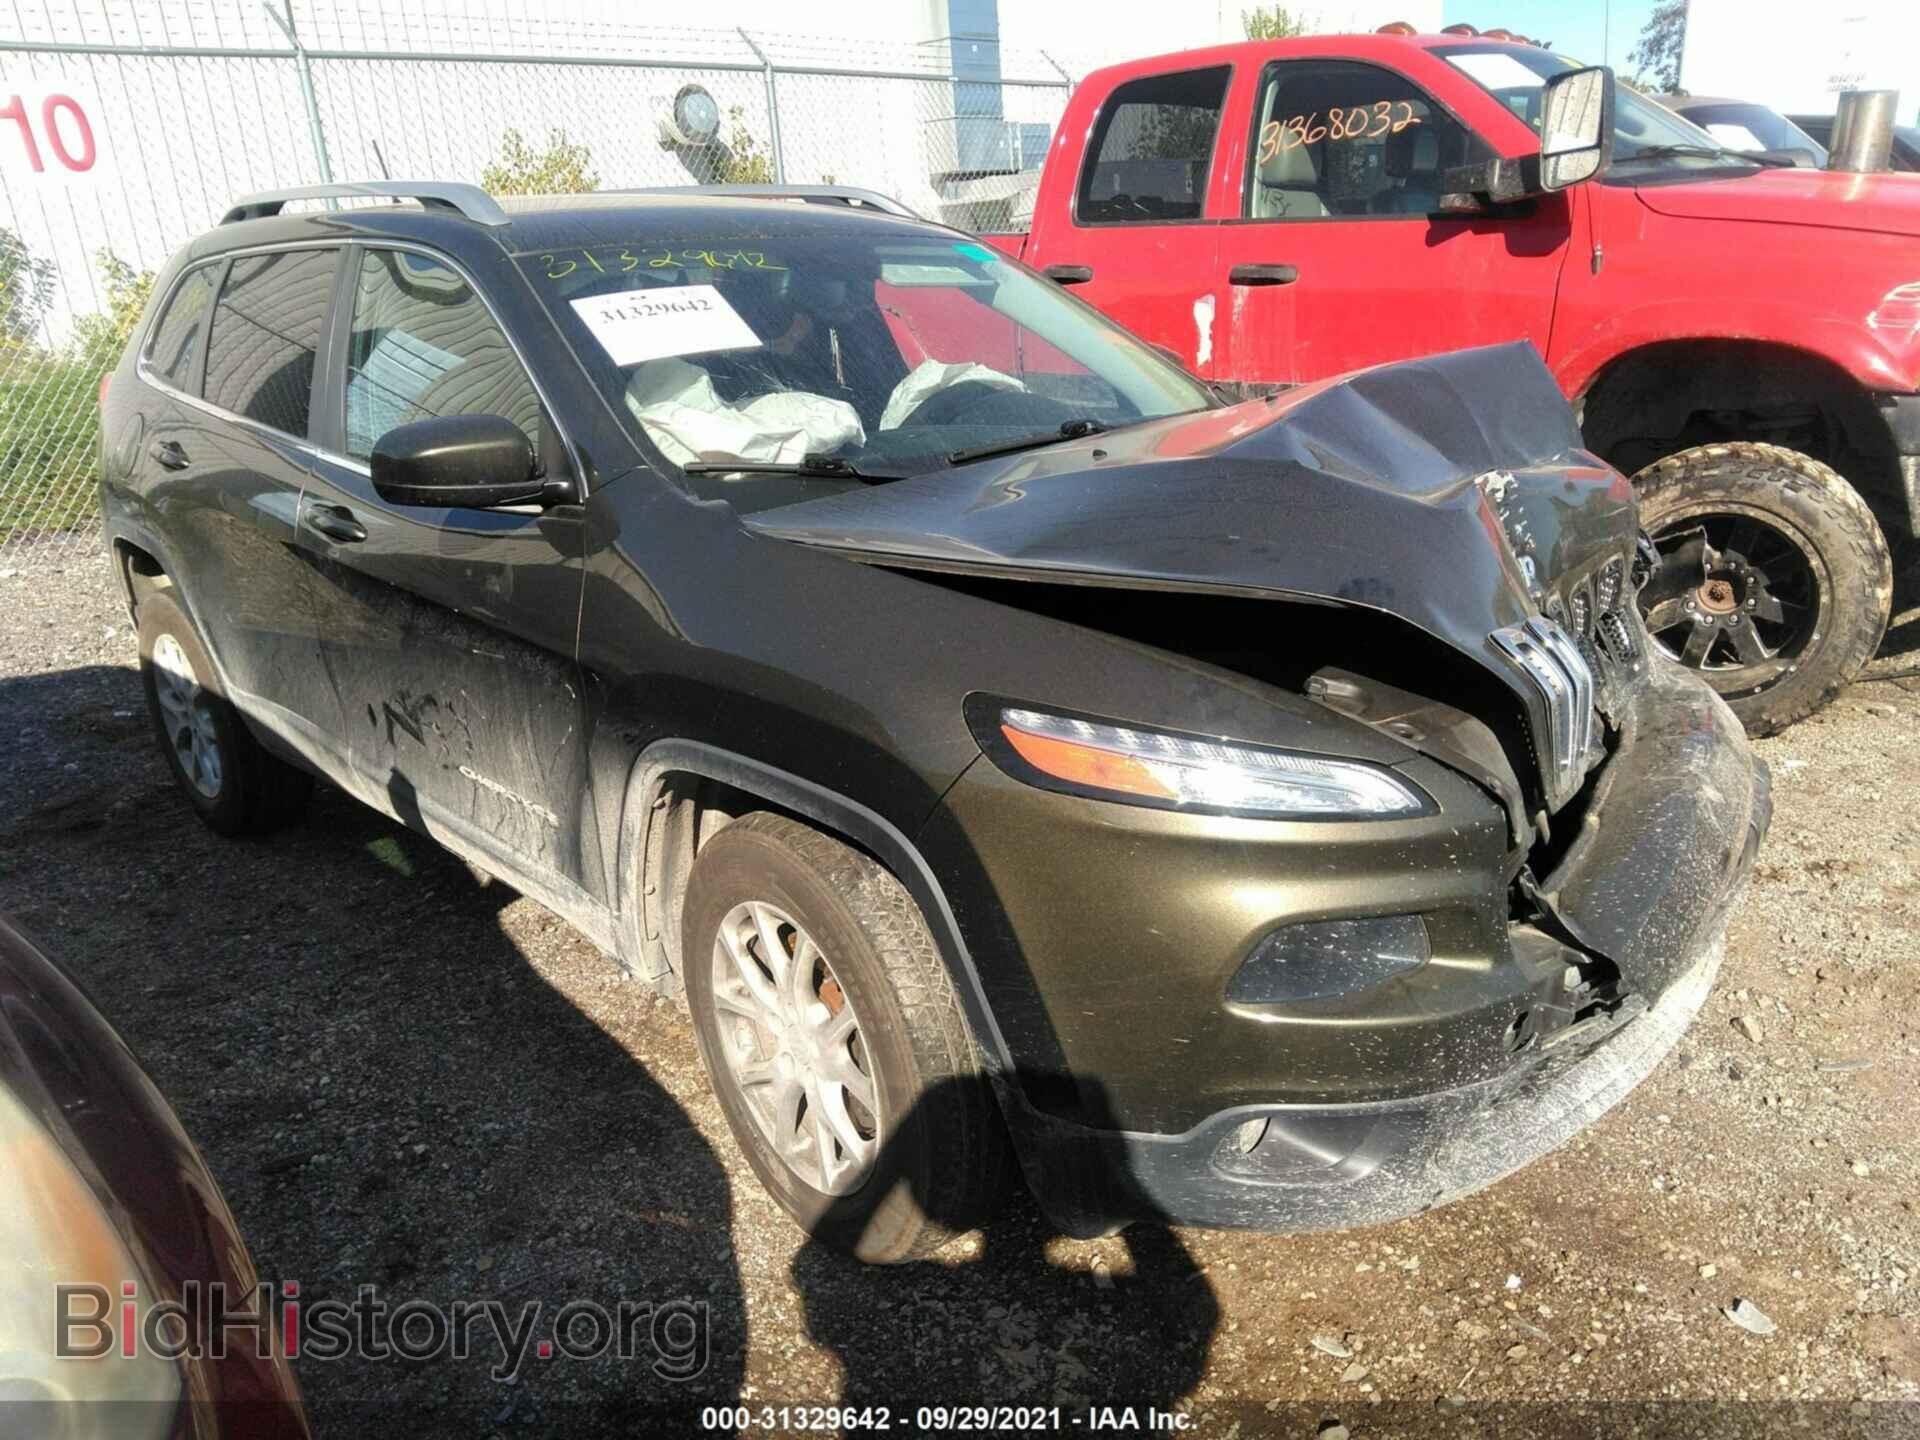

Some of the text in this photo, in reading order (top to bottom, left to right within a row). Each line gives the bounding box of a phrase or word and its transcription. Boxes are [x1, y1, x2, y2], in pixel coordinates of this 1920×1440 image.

[0, 94, 97, 172] 10
[1260, 100, 1423, 168] 31368032
[600, 299, 714, 324] 31329642
